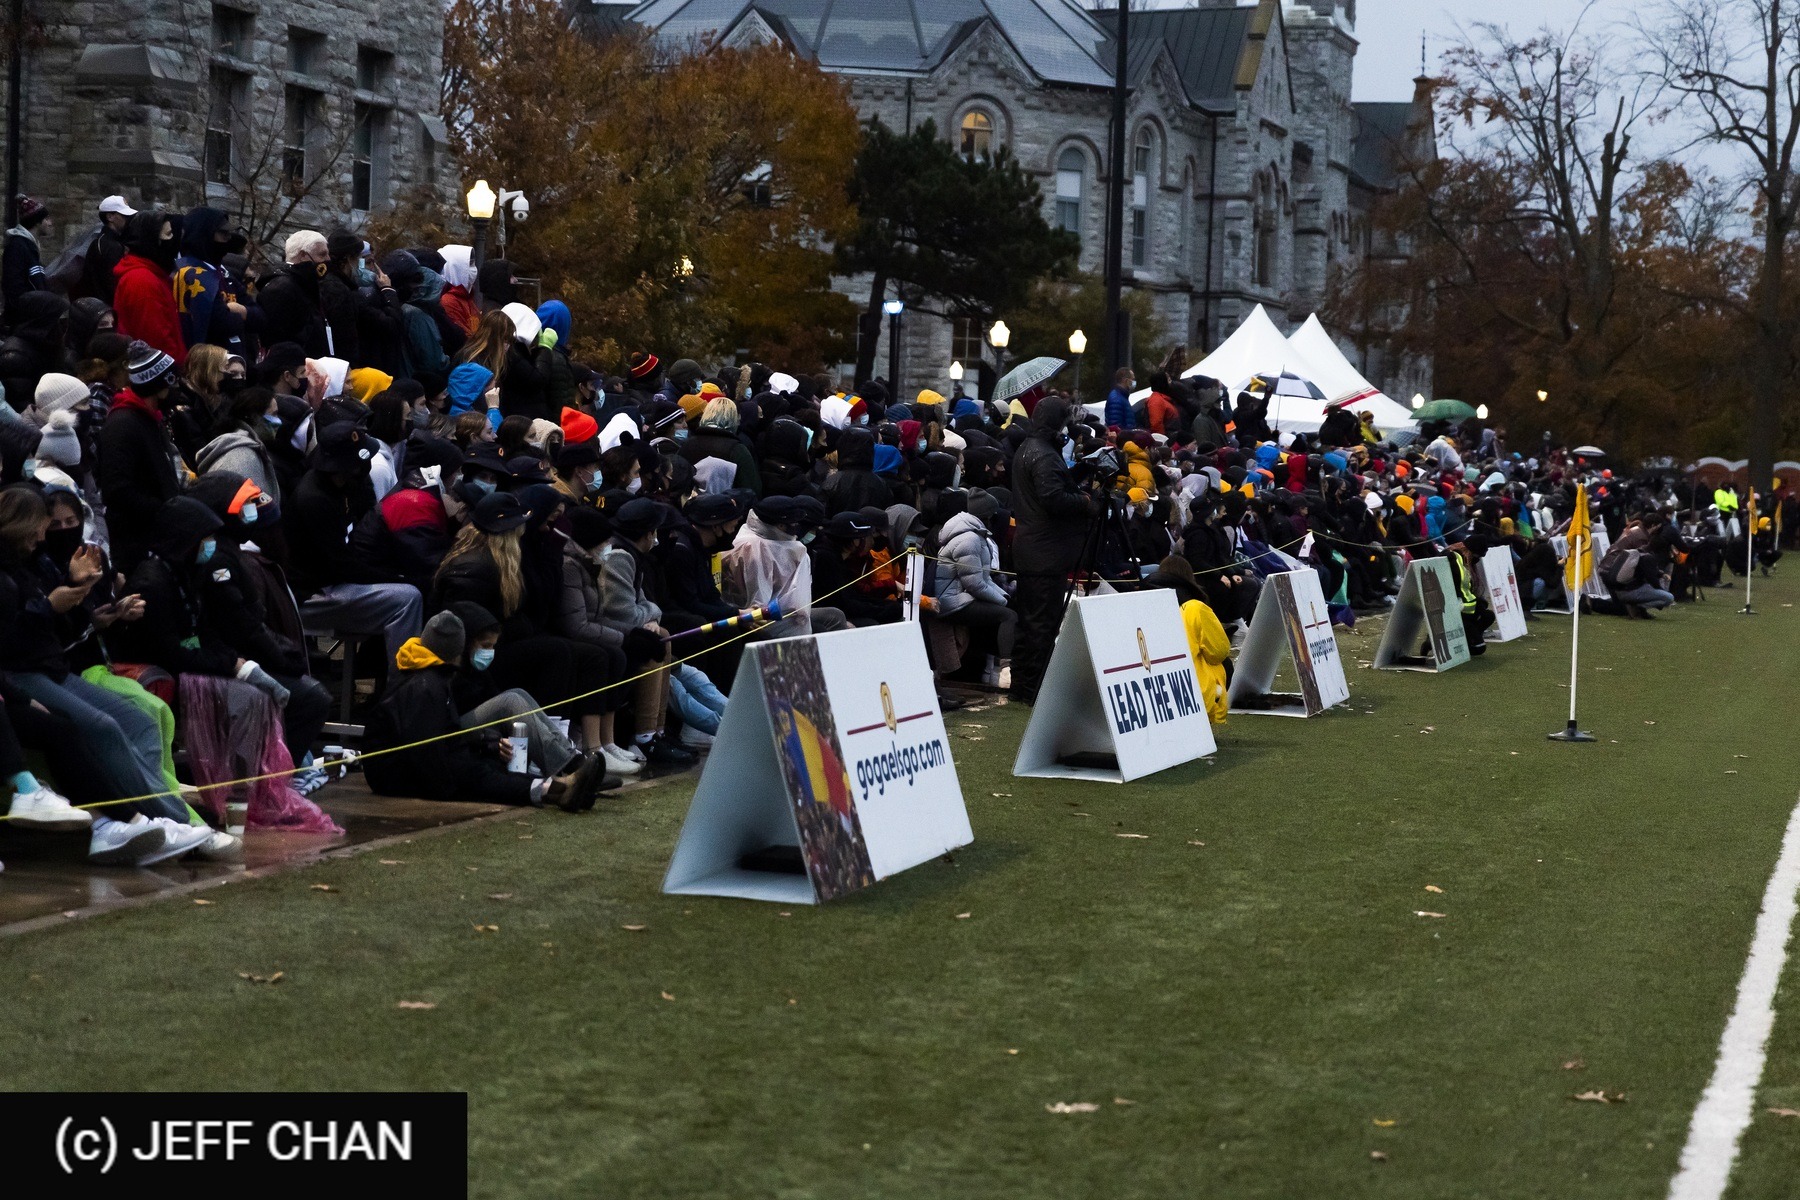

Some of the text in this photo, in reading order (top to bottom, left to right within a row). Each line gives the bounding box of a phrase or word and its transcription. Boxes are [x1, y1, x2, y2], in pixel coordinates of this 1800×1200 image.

[1107, 668, 1200, 734] LEAD THE WAY.
[857, 740, 945, 801] gogaelsgo.com
